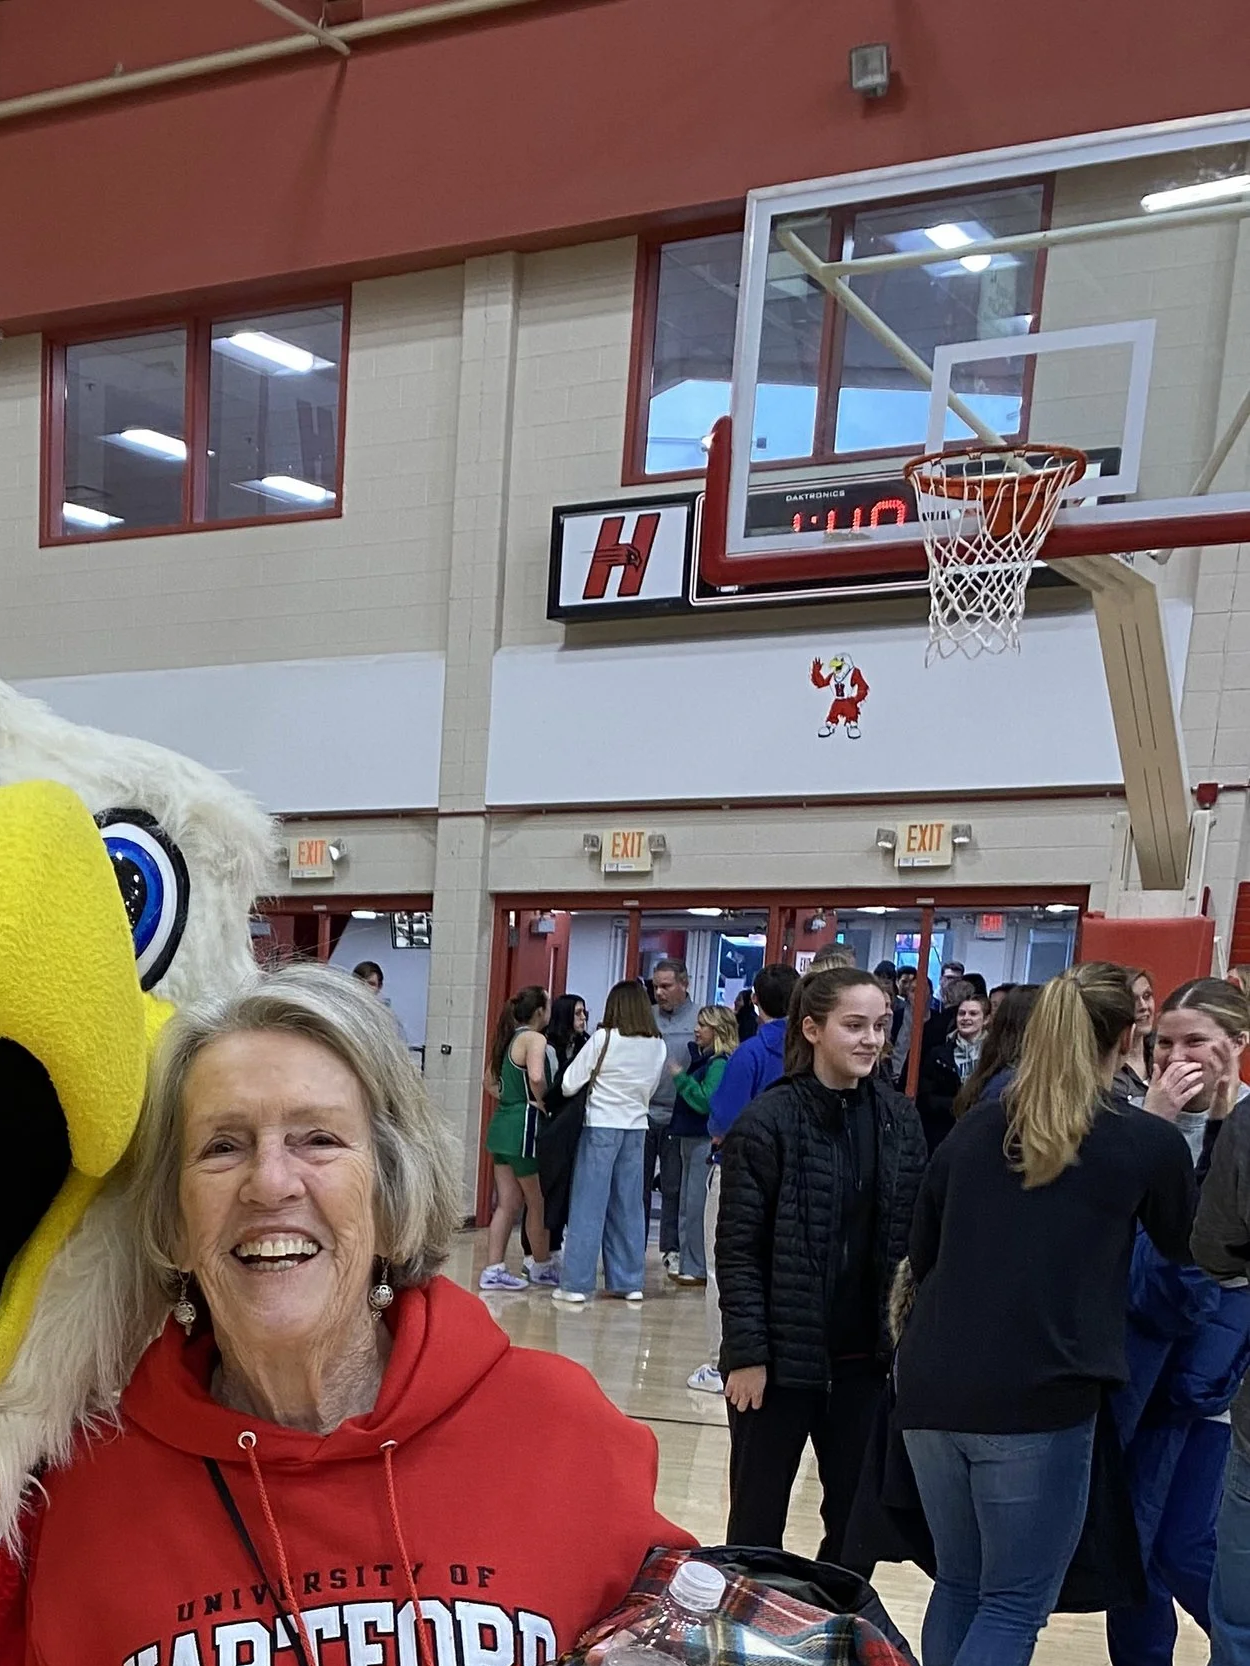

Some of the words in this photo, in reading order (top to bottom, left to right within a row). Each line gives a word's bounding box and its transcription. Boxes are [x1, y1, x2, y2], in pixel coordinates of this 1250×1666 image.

[785, 490, 846, 502] DAKTRONICS
[611, 832, 645, 858] EXIT
[907, 823, 945, 853] EXIT
[298, 839, 327, 866] EXIT
[450, 1563, 496, 1588] OF
